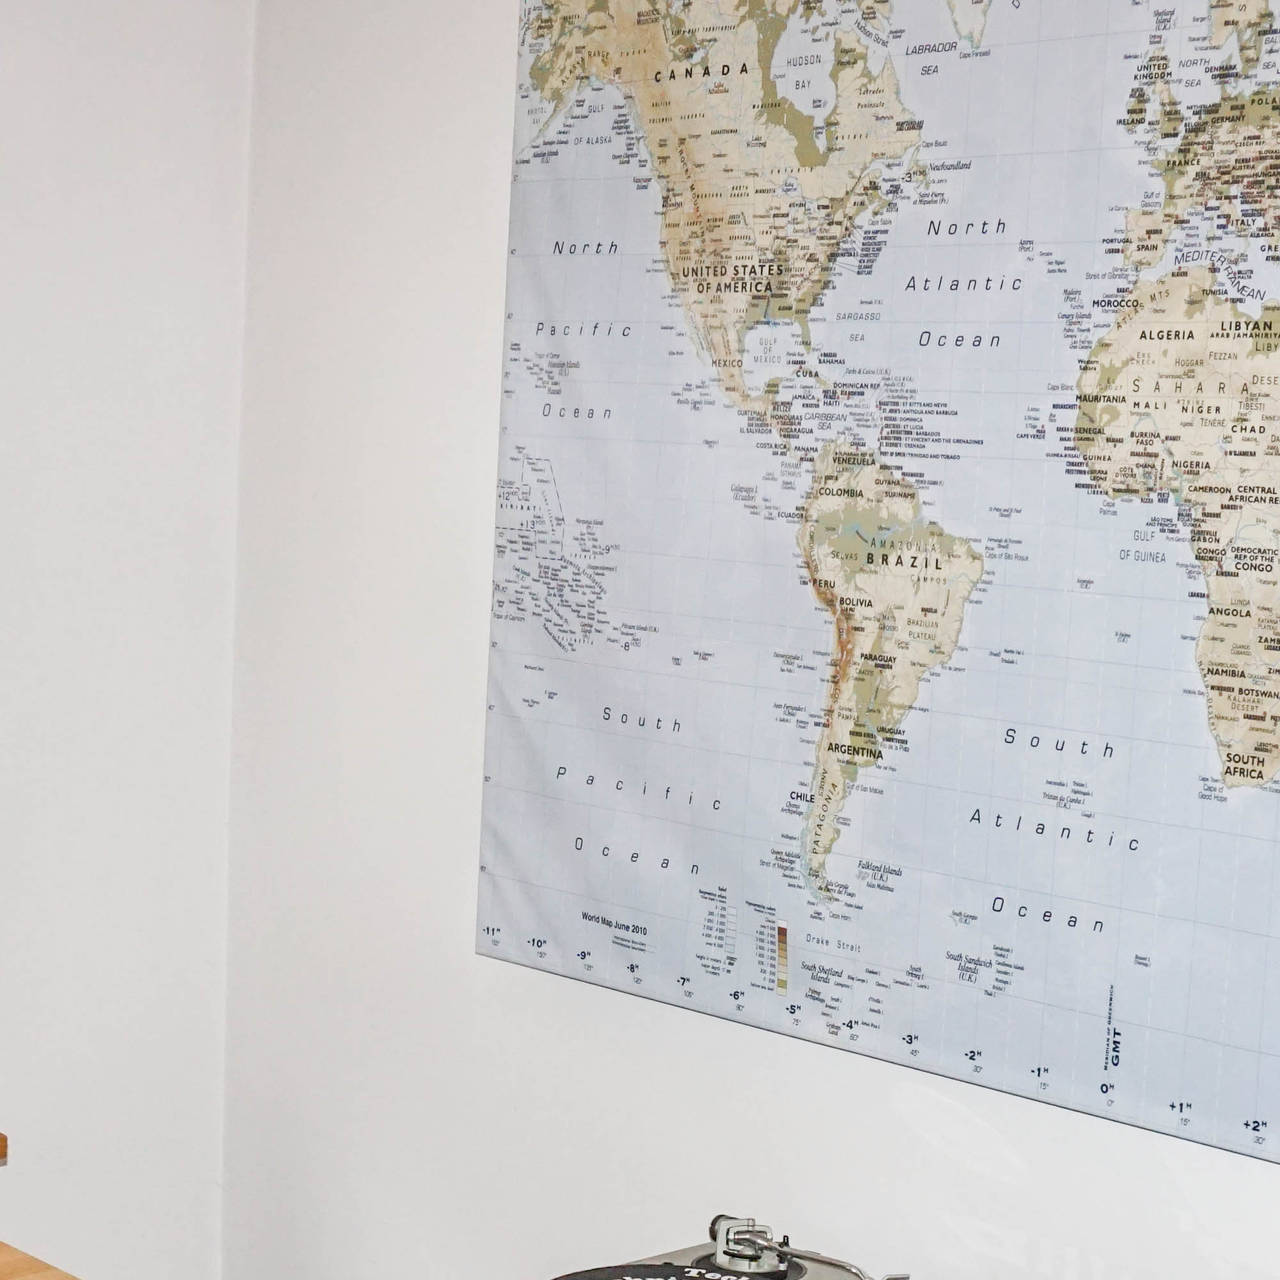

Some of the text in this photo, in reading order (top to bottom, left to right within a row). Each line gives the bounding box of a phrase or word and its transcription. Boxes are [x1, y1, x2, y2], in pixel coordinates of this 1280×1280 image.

[905, 41, 958, 55] LABRADOR
[786, 54, 821, 67] HUDSON
[654, 62, 749, 82] CANADA
[921, 65, 938, 76] SEA
[795, 79, 811, 90] BAY
[928, 218, 1006, 236] North
[553, 240, 618, 255] North
[682, 264, 783, 277] UNITED STATES
[697, 282, 773, 294] OF AMERICA
[906, 275, 1023, 292] Atlantic
[536, 321, 632, 338] Pacific
[1140, 330, 1194, 340] ALGERIA
[920, 331, 1001, 348] Ocean
[795, 370, 819, 379] CUBA
[1132, 381, 1250, 395] SAHARA
[543, 403, 612, 420] Ocean
[832, 457, 876, 467] VENEZUELA
[819, 489, 864, 499] COLOMBIA
[867, 553, 941, 570] BRAZIL
[1235, 563, 1272, 573] CONGO
[1208, 608, 1251, 617] ANGOLA
[1207, 669, 1246, 678] NAMIBIA
[602, 706, 681, 733] South
[1004, 728, 1115, 760] South
[827, 743, 883, 760] ARGENTINA
[1226, 754, 1265, 766] SOUTH
[1225, 767, 1264, 780] AFRICA
[555, 766, 722, 812] Pacific
[790, 792, 814, 803] CHILE
[969, 808, 1139, 852] Atlantic
[575, 838, 699, 876] Ocean
[992, 896, 1104, 932] Ocean
[582, 911, 648, 936] World Map June 2010
[1112, 1028, 1121, 1067] GMT
